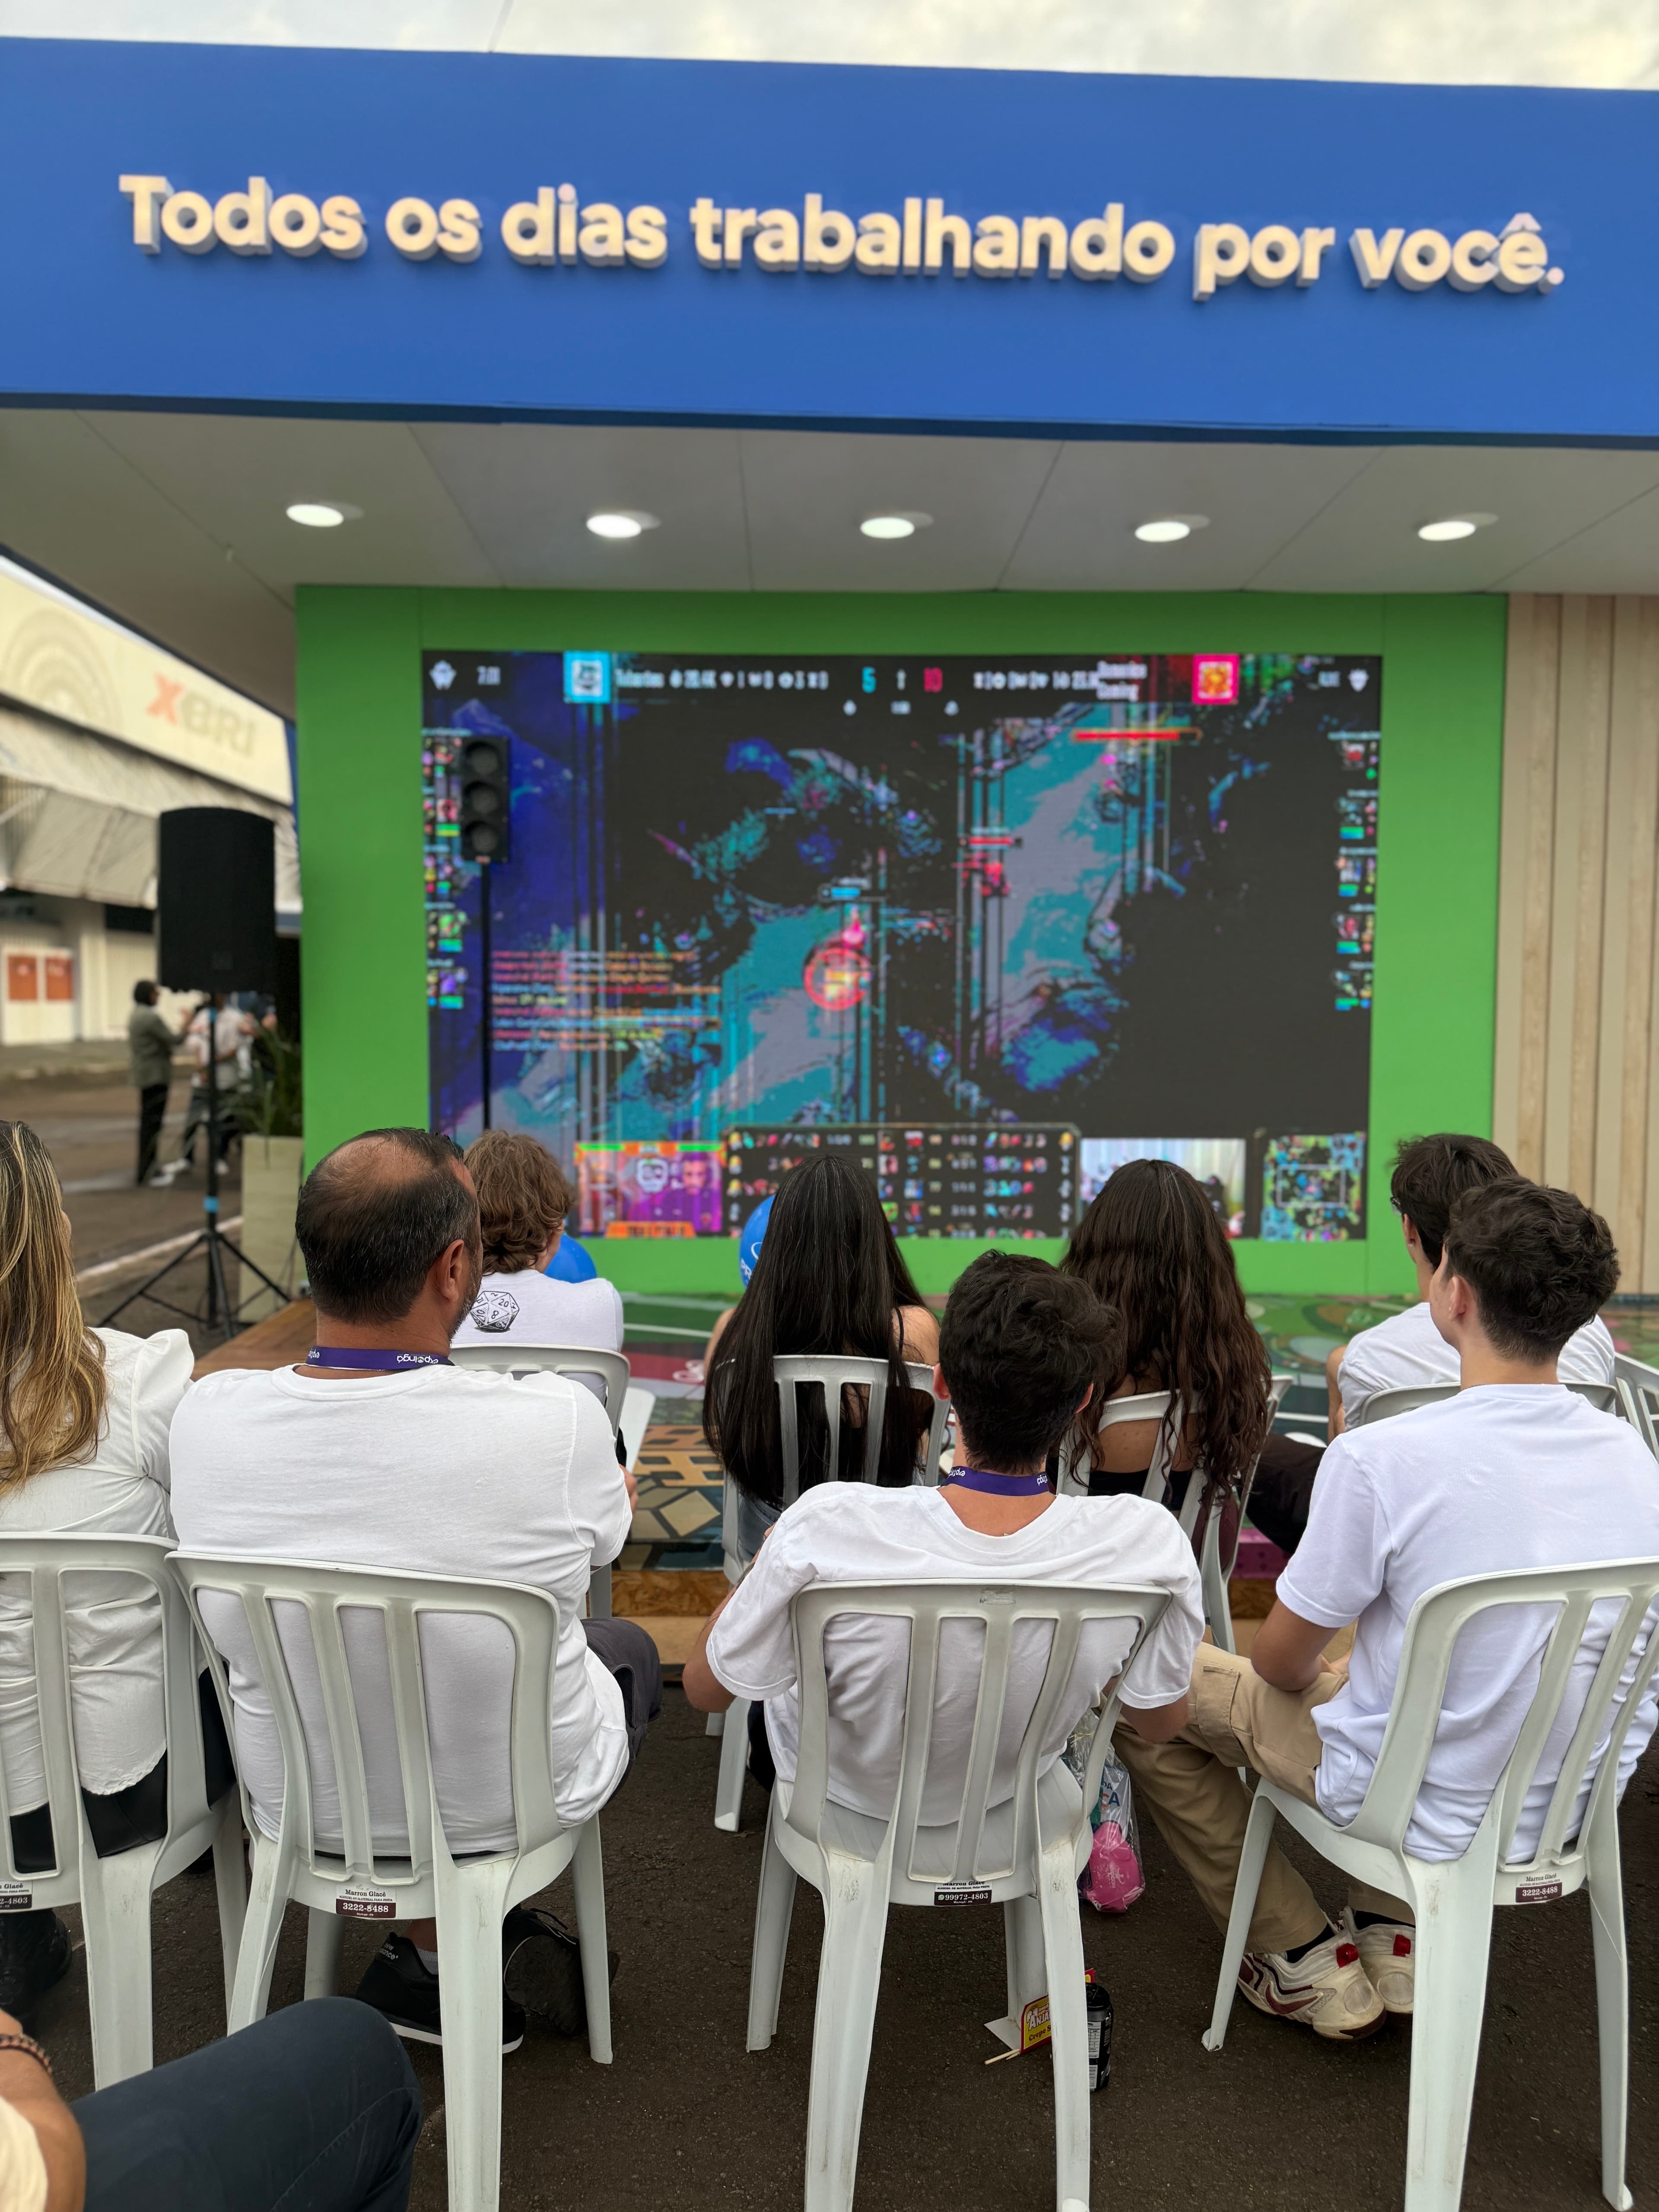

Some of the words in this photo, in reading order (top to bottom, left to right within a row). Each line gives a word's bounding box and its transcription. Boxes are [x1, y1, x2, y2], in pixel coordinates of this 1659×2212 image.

[119, 174, 368, 260] Todos
[385, 197, 482, 263] os
[501, 184, 668, 268] dias
[690, 194, 1175, 283] trabalhando
[1193, 223, 1336, 301] por
[1349, 213, 1565, 294] você.
[498, 1299, 509, 1307] 20
[491, 1310, 499, 1319] 8
[1522, 1886, 1558, 1897] 3222-8488
[343, 1903, 388, 1913] 3222-8488
[1029, 2029, 1046, 2041] Crepe
